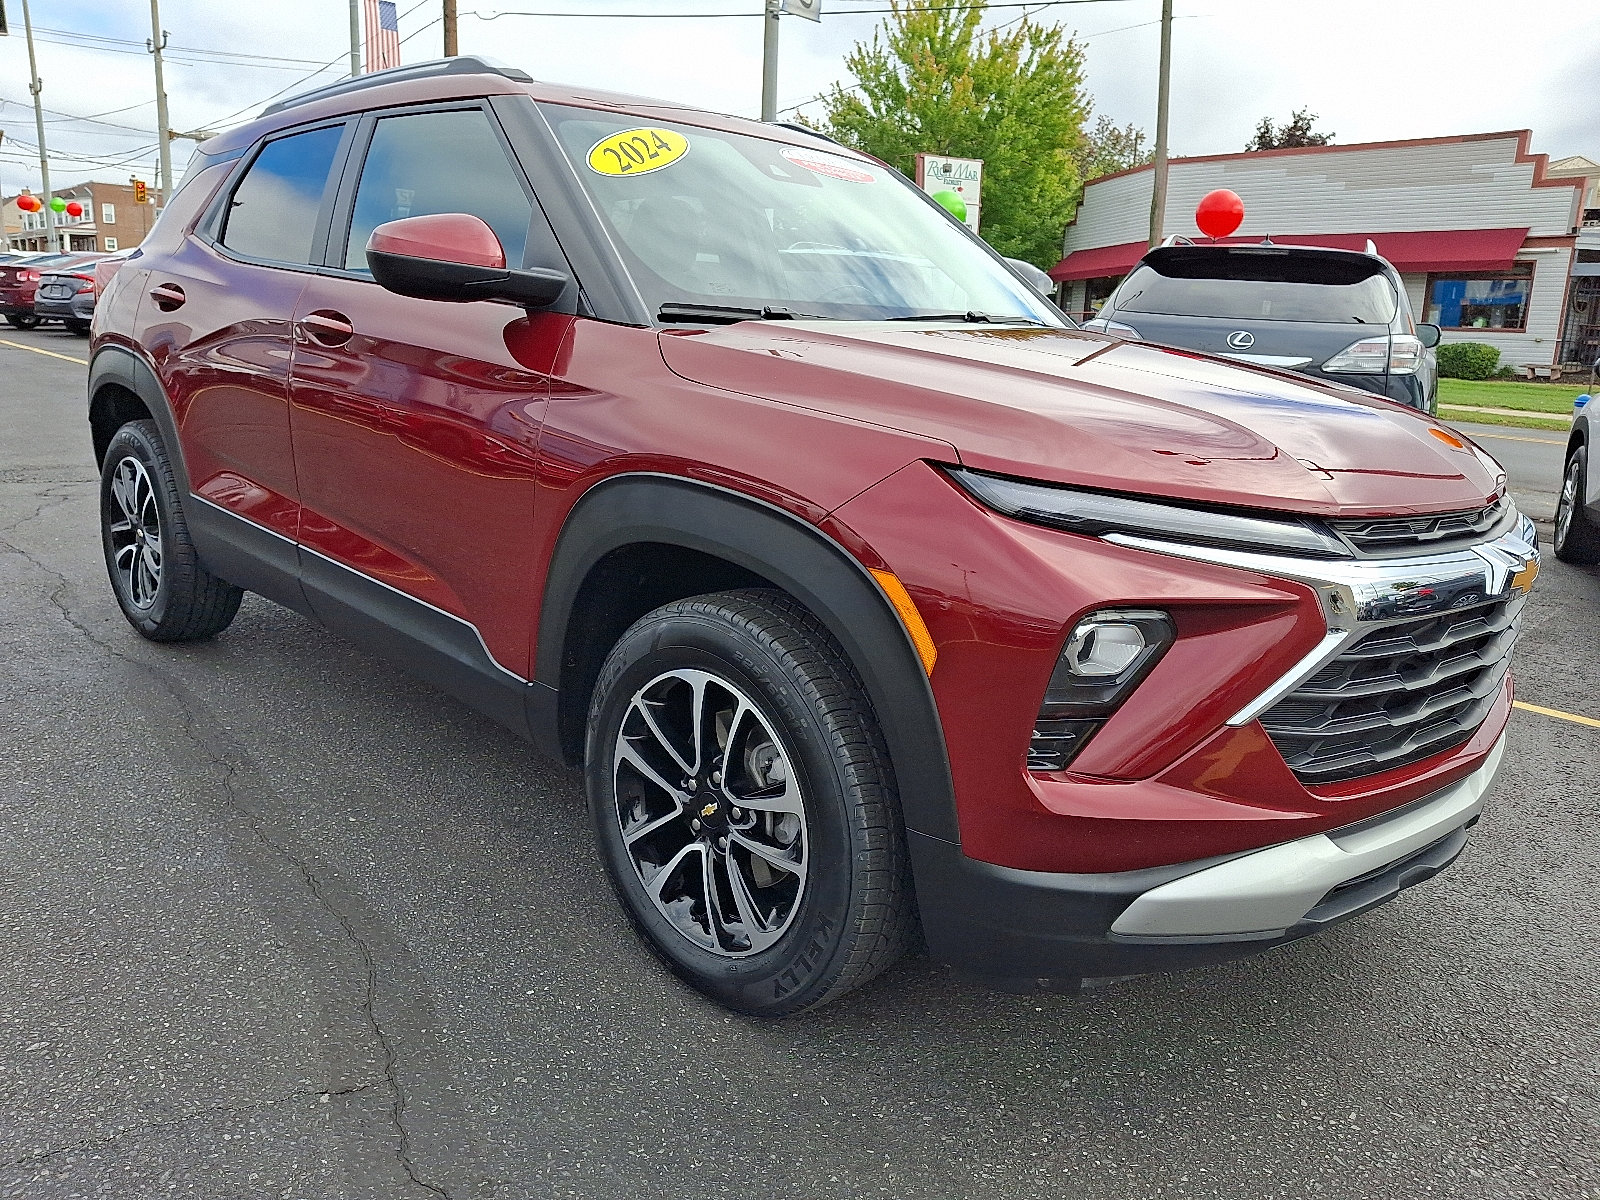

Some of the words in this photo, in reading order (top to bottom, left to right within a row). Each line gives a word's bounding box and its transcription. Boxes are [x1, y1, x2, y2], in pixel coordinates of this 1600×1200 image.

[603, 130, 672, 172] 2024
[953, 163, 978, 181] MAR
[773, 911, 834, 999] KELLY
